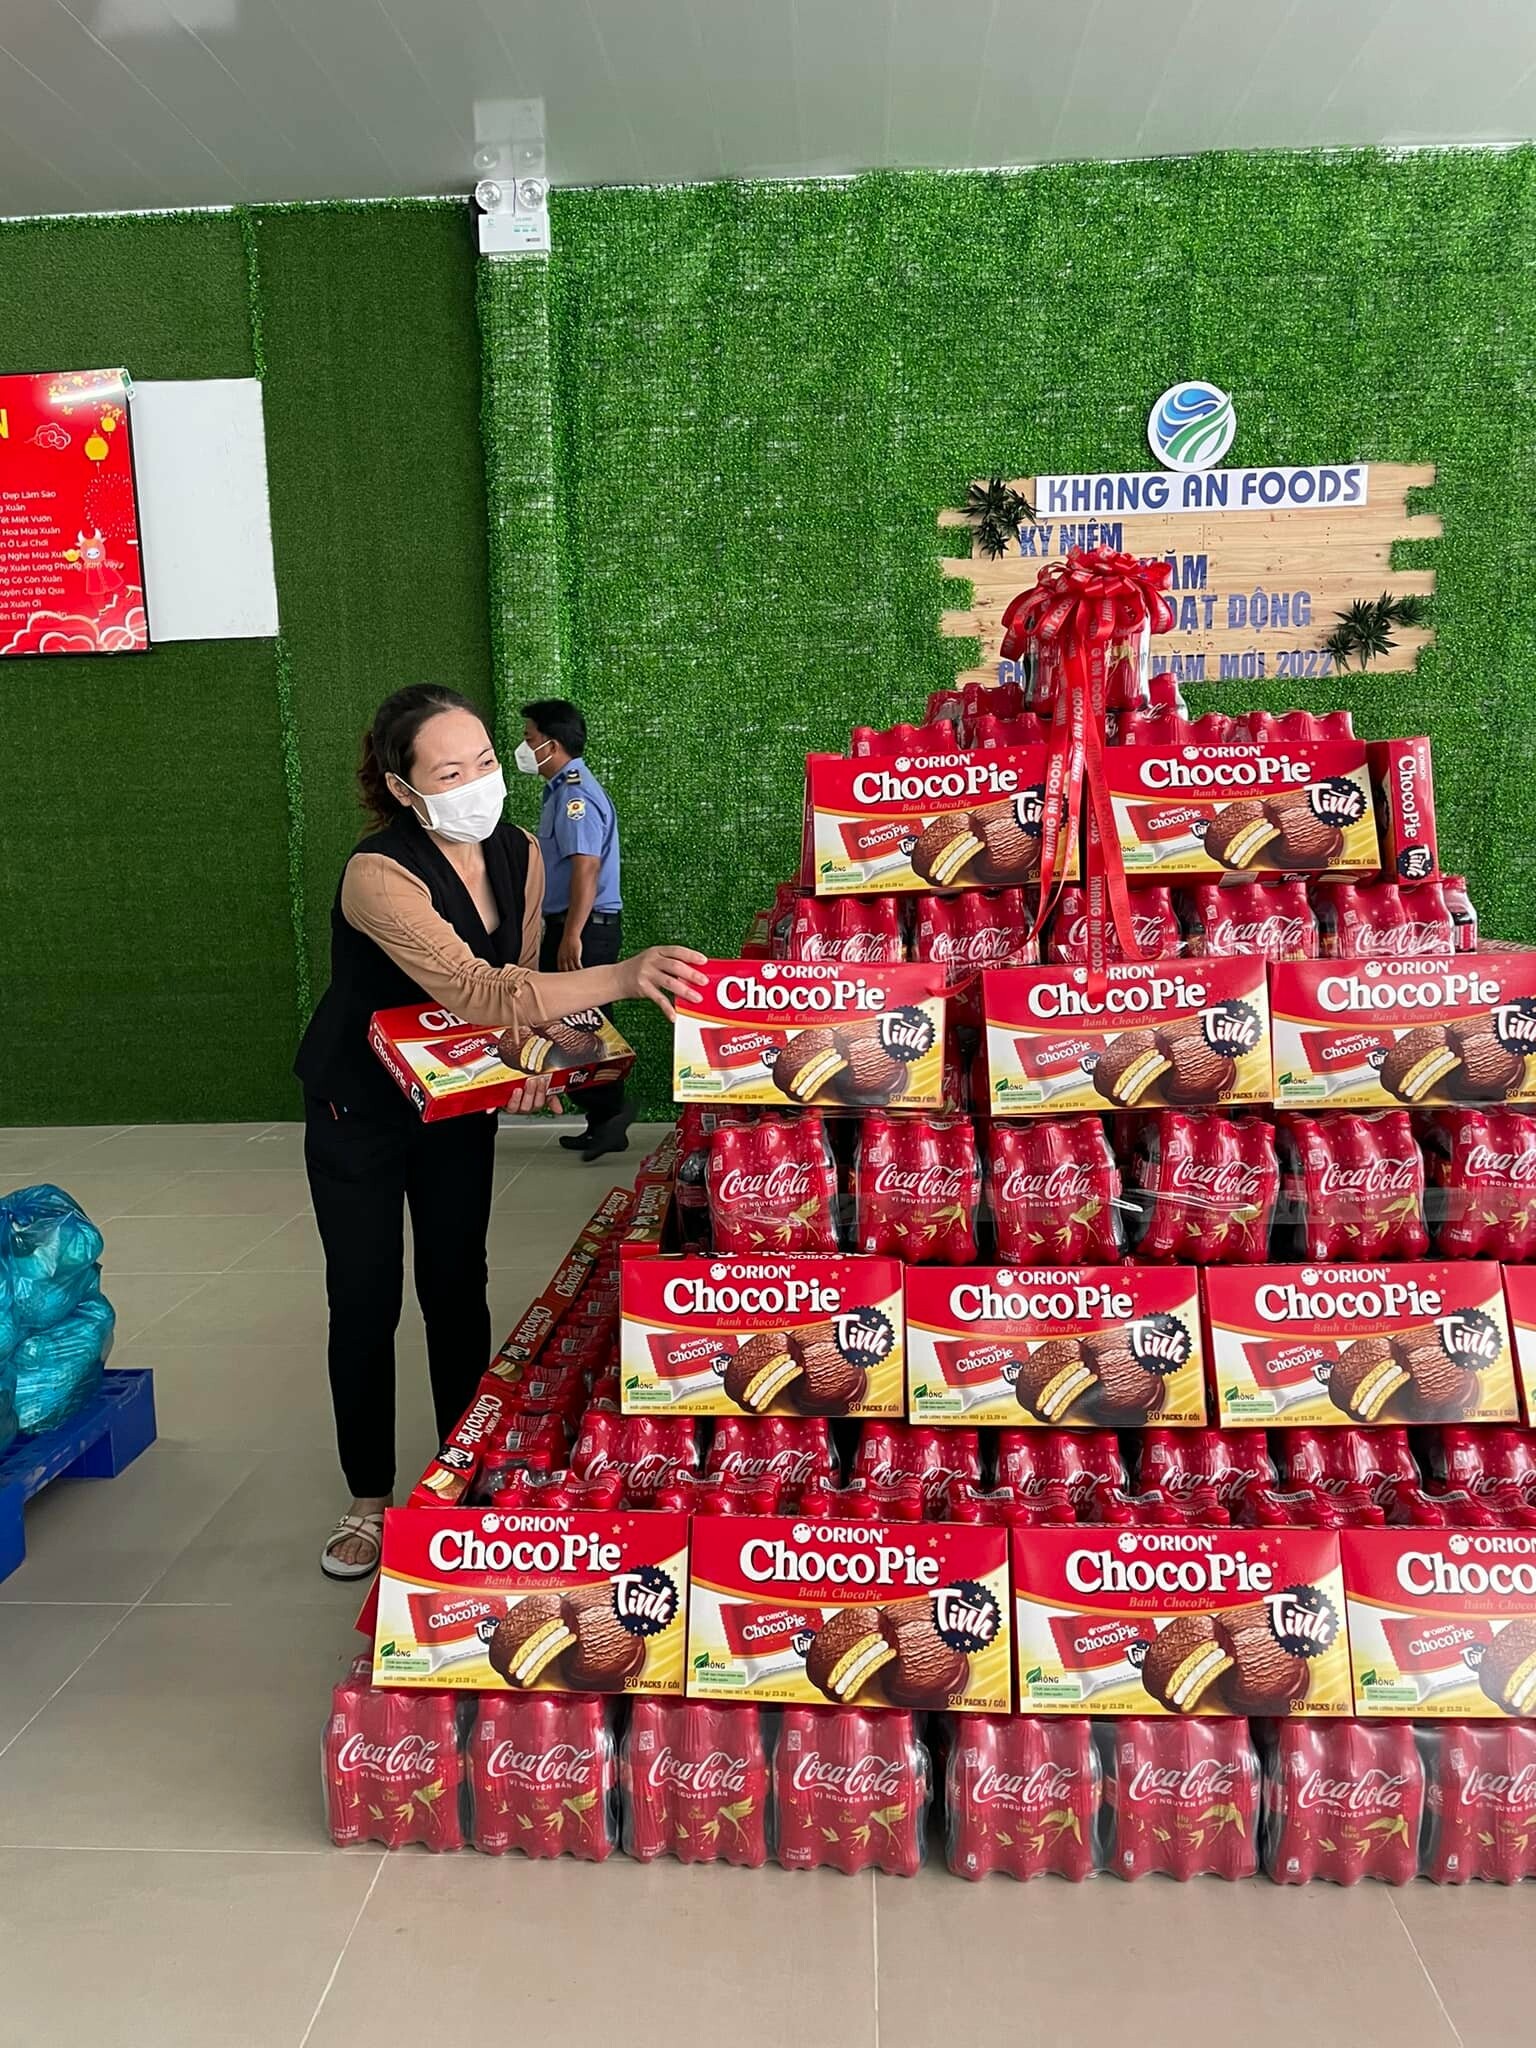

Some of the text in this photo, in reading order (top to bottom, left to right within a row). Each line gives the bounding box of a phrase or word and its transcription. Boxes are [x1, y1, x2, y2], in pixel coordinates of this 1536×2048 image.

[1048, 469, 1361, 512] KHANG AN FOODS
[21, 527, 38, 535] Mùa
[32, 563, 52, 572] Long
[10, 600, 30, 608] Xuân
[1227, 586, 1312, 633] ĐỘNG
[1219, 646, 1266, 680] MỚI
[1276, 648, 1333, 679] 2022
[1073, 724, 1083, 740] AN
[916, 755, 971, 769] ORION
[1072, 742, 1082, 783] KHANG
[1202, 745, 1261, 757] ORION
[853, 762, 1018, 805] ChocoPie
[1139, 755, 1311, 788] ChocoPie
[1044, 753, 1063, 860] KHANG AN FOODS
[1398, 755, 1421, 838] ChocoPie
[1148, 809, 1201, 831] ChocoPie
[857, 824, 910, 849] ChocoPie
[1328, 857, 1340, 865] 20
[1215, 915, 1304, 948] Coca-Cola
[781, 965, 839, 979] ORION
[1386, 961, 1449, 975] ORION
[716, 976, 886, 1011] ChocoPie
[1317, 971, 1500, 1012] ChocoPie
[719, 1034, 773, 1057] ChocoPie
[1035, 1040, 1091, 1067] ChocoPie
[1322, 1036, 1381, 1061] ChocoPie
[373, 1036, 408, 1088] ChocoPie
[1220, 1091, 1232, 1100] 20
[1507, 1089, 1518, 1098] 20
[719, 1161, 814, 1202] Coca-Cola
[875, 1162, 968, 1198] Coca-Cola
[1002, 1162, 1094, 1202] Coca-Cola
[1173, 1156, 1266, 1196] Coca-Cola
[1320, 1158, 1418, 1195] Coca-Cola
[555, 1262, 588, 1297] ChocoPie
[731, 1264, 791, 1279] ORION
[1018, 1270, 1080, 1286] ORION
[1323, 1268, 1387, 1283] ORION
[663, 1278, 841, 1315] ChocoPie
[950, 1283, 1135, 1322] ChocoPie
[1254, 1280, 1442, 1322] ChocoPie
[519, 1306, 552, 1345] ChocoPie
[667, 1339, 724, 1364] ChocoPie
[956, 1347, 1014, 1373] ChocoPie
[1266, 1347, 1324, 1374] ChocoPie
[455, 1393, 502, 1445] ChocoPie
[850, 1403, 861, 1412] 20
[1150, 1411, 1181, 1421] 20 PACKS
[503, 1515, 570, 1532] ORION
[815, 1528, 884, 1544] ORION
[429, 1529, 622, 1573] ChocoPie
[1142, 1535, 1213, 1551] ORION
[739, 1538, 940, 1586] ChocoPie
[1065, 1549, 1273, 1593] ChocoPie
[1396, 1551, 1536, 1596] Choco
[831, 1588, 883, 1601] ChocoPie
[1163, 1597, 1217, 1609] ChocoPie
[428, 1601, 491, 1629] ChocoPie
[742, 1612, 806, 1641] ChocoPie
[1074, 1624, 1139, 1654] ChocoPie
[1409, 1628, 1474, 1656] ChocoPie
[625, 1678, 638, 1688] 20
[639, 1680, 661, 1689] PACKS
[949, 1694, 962, 1706] 20
[964, 1698, 987, 1707] PACKS
[1291, 1700, 1331, 1711] 20 PACKS
[338, 1732, 441, 1774] Coca-Cola
[487, 1740, 596, 1784] Coca-Cola
[648, 1746, 751, 1792] Coca-Cola
[792, 1751, 905, 1796] Coca-Cola
[972, 1761, 1078, 1803] Coca-Cola
[1128, 1759, 1241, 1802] Coca-Cola
[1298, 1768, 1408, 1809] Coca-Cola
